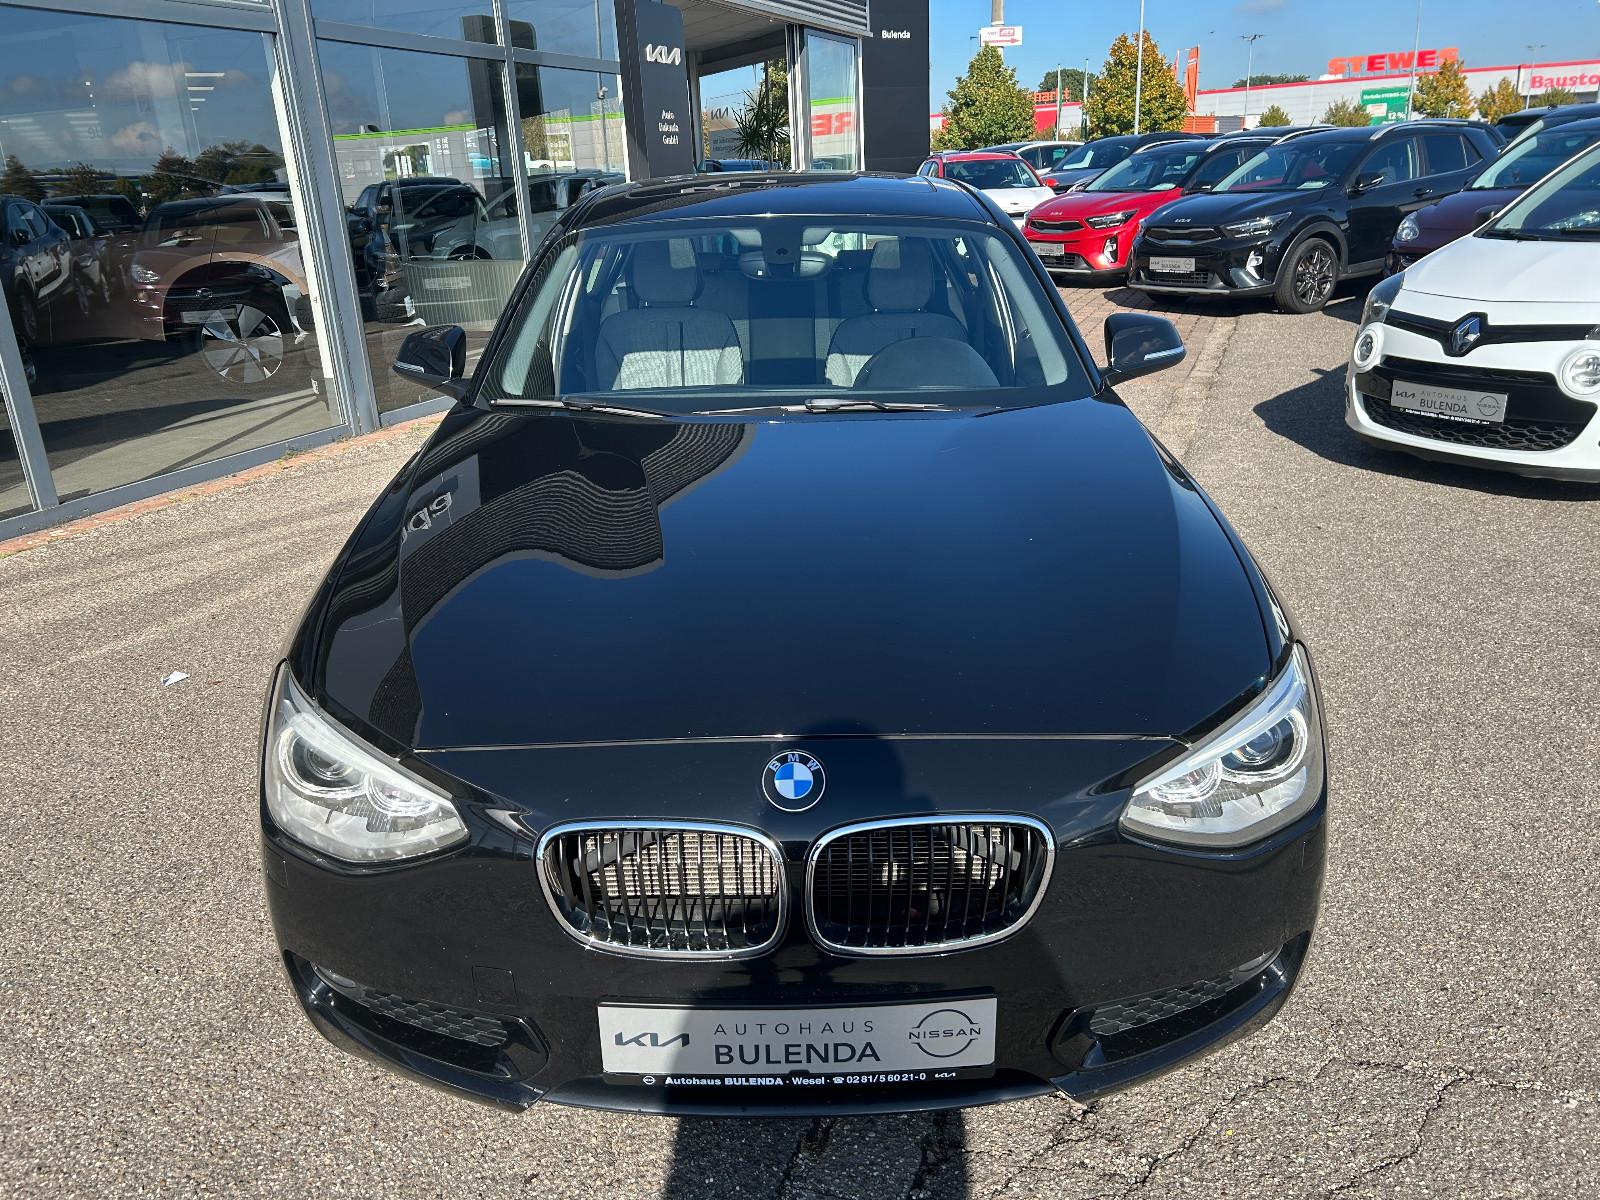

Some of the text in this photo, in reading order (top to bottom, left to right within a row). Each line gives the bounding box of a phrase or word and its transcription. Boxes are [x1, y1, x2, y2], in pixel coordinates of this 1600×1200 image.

[881, 29, 911, 39] Bulenda
[1419, 398, 1468, 414] BULENDA
[768, 753, 820, 772] BMW
[713, 1020, 875, 1036] AUTOHAUS
[908, 1027, 981, 1040] NISSAN
[614, 1031, 691, 1048] KIA
[714, 1041, 881, 1065] BULENDA
[664, 1076, 722, 1086] Autohaus
[724, 1077, 784, 1086] BULENDA
[791, 1076, 825, 1086] Wesel
